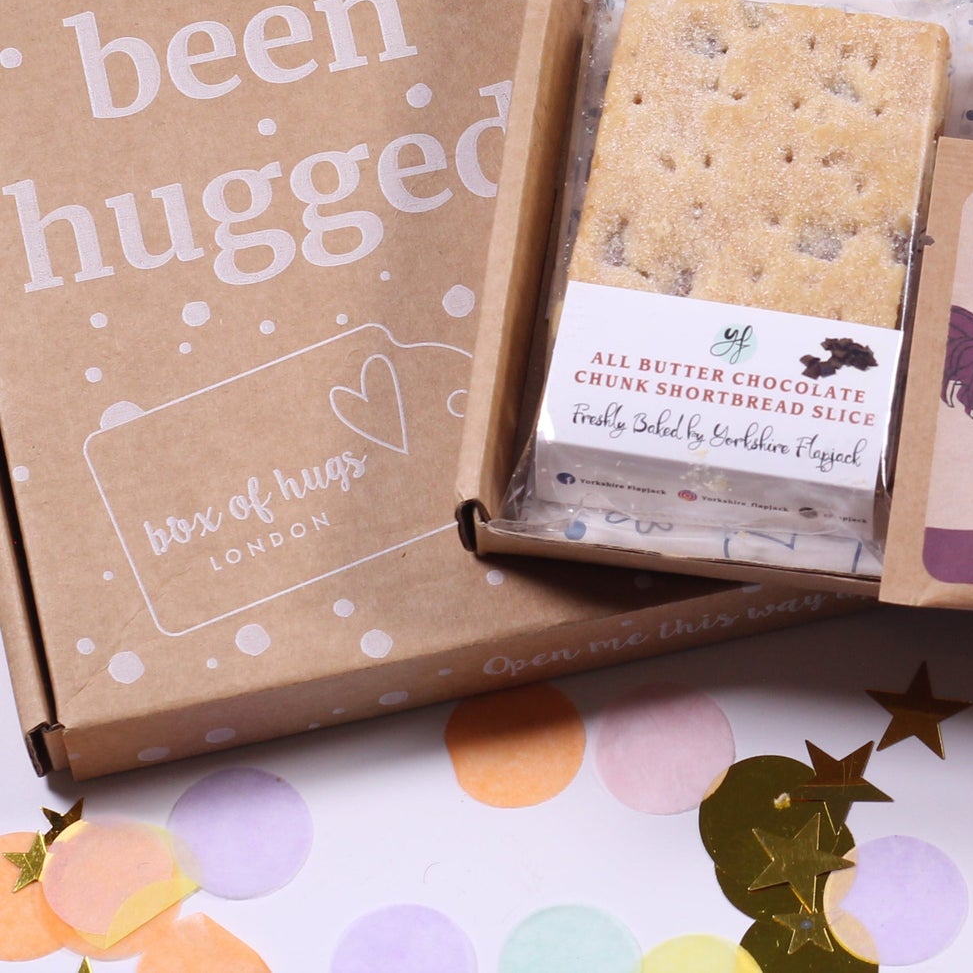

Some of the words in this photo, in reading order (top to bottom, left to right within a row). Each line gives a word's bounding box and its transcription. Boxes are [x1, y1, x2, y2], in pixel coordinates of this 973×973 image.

[574, 369, 648, 393] CHUNK
[655, 381, 805, 416] SHORTBREAD
[811, 404, 876, 426] SLICE
[590, 351, 631, 369] ALL
[638, 357, 724, 383] BUTTER
[732, 371, 867, 403] CHOCOLATE
[572, 402, 626, 438] Freshly
[632, 409, 684, 440] Baked
[687, 414, 706, 450] by
[710, 422, 790, 455] Yorkshire
[795, 434, 868, 473] Flapjack
[144, 507, 223, 556] box
[228, 477, 274, 523] of
[273, 450, 368, 499] hugs
[210, 511, 331, 571] LONDON
[482, 645, 580, 676] Open
[589, 630, 648, 654] me
[659, 610, 740, 640] this
[748, 591, 827, 622] way
